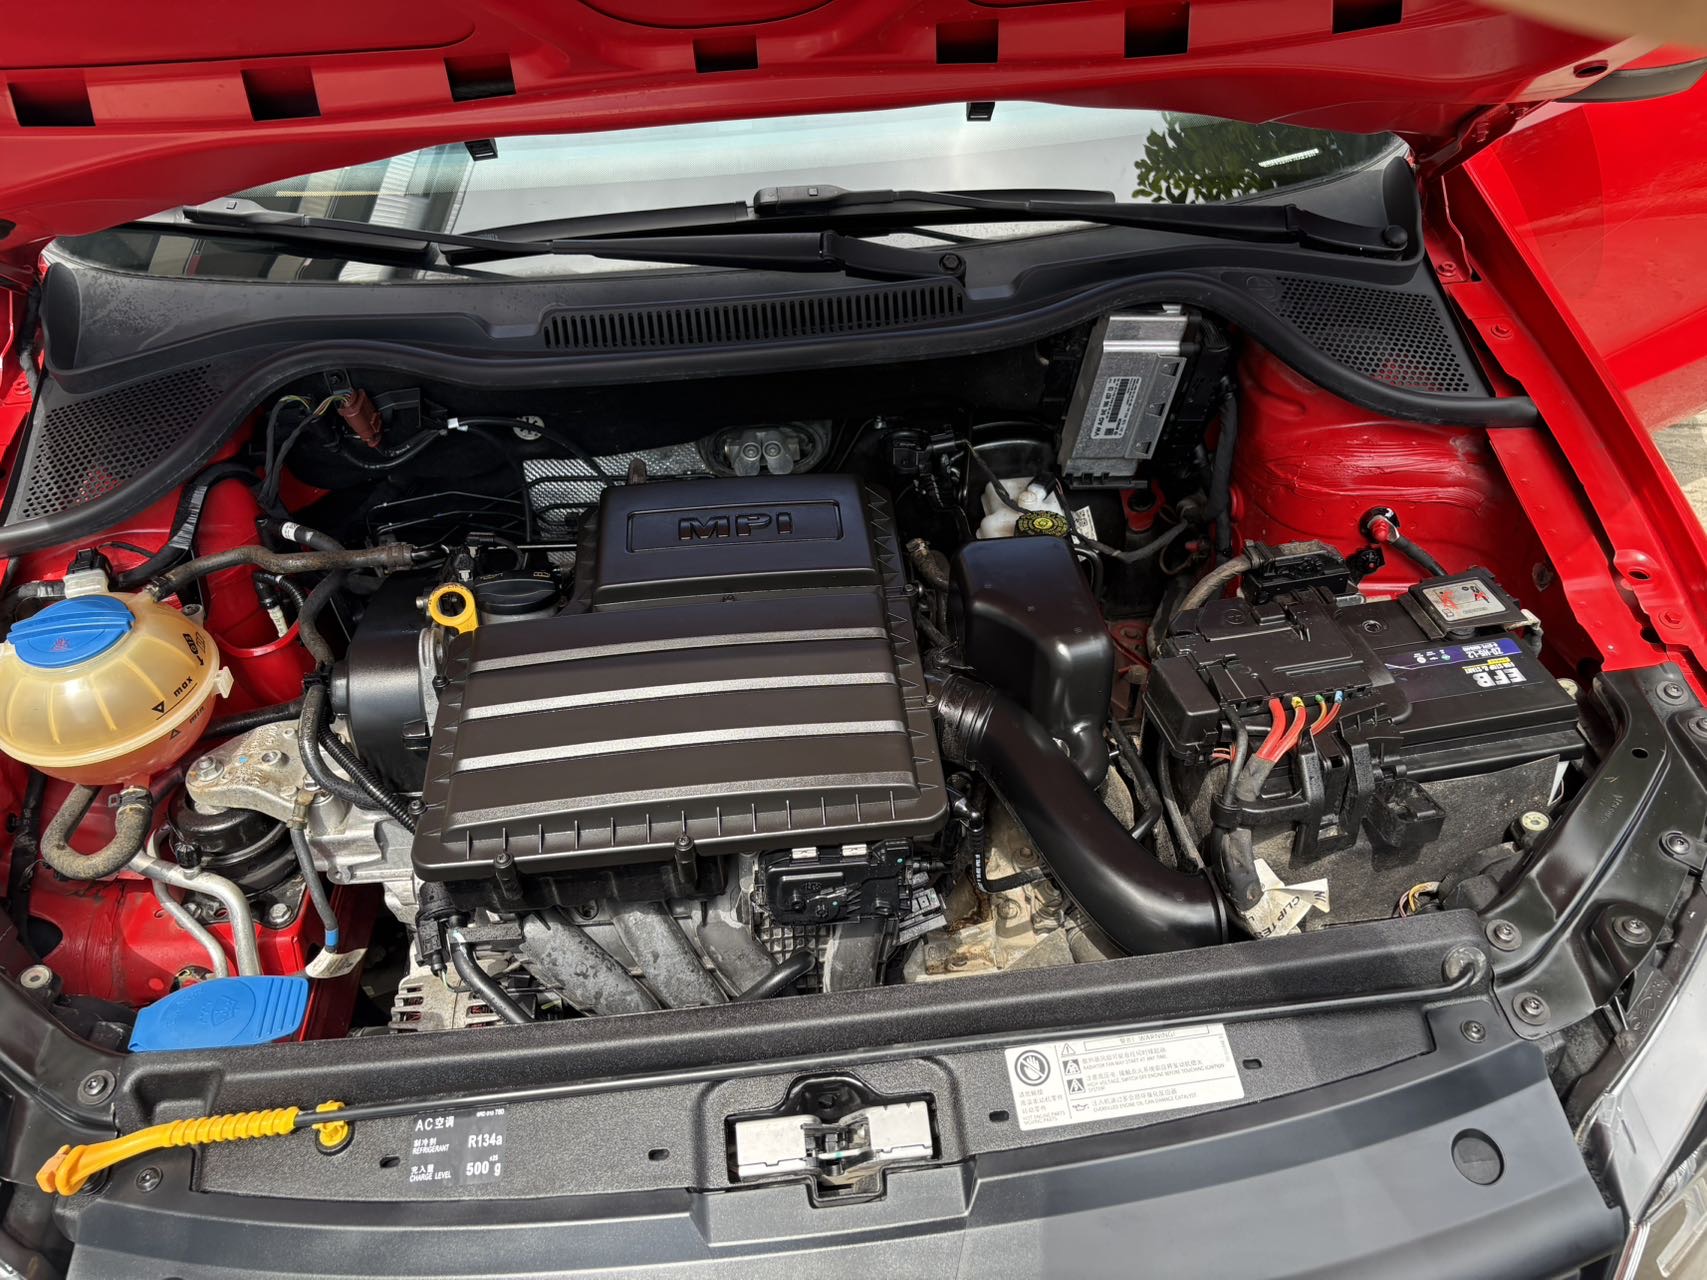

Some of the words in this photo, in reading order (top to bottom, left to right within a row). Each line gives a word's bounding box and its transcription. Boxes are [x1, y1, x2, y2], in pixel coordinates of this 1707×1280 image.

[678, 512, 793, 540] MPI
[174, 676, 193, 697] max
[1473, 668, 1527, 688] EFB
[189, 706, 205, 724] min
[1278, 896, 1300, 921] CLIP
[415, 1116, 455, 1132] AC空调
[468, 1133, 503, 1148] R134a
[413, 1144, 450, 1155] REFRIGERANT
[410, 1173, 433, 1183] CHARGE
[435, 1171, 451, 1180] LEVEL
[466, 1161, 490, 1176] 500
[494, 1163, 501, 1177] g
